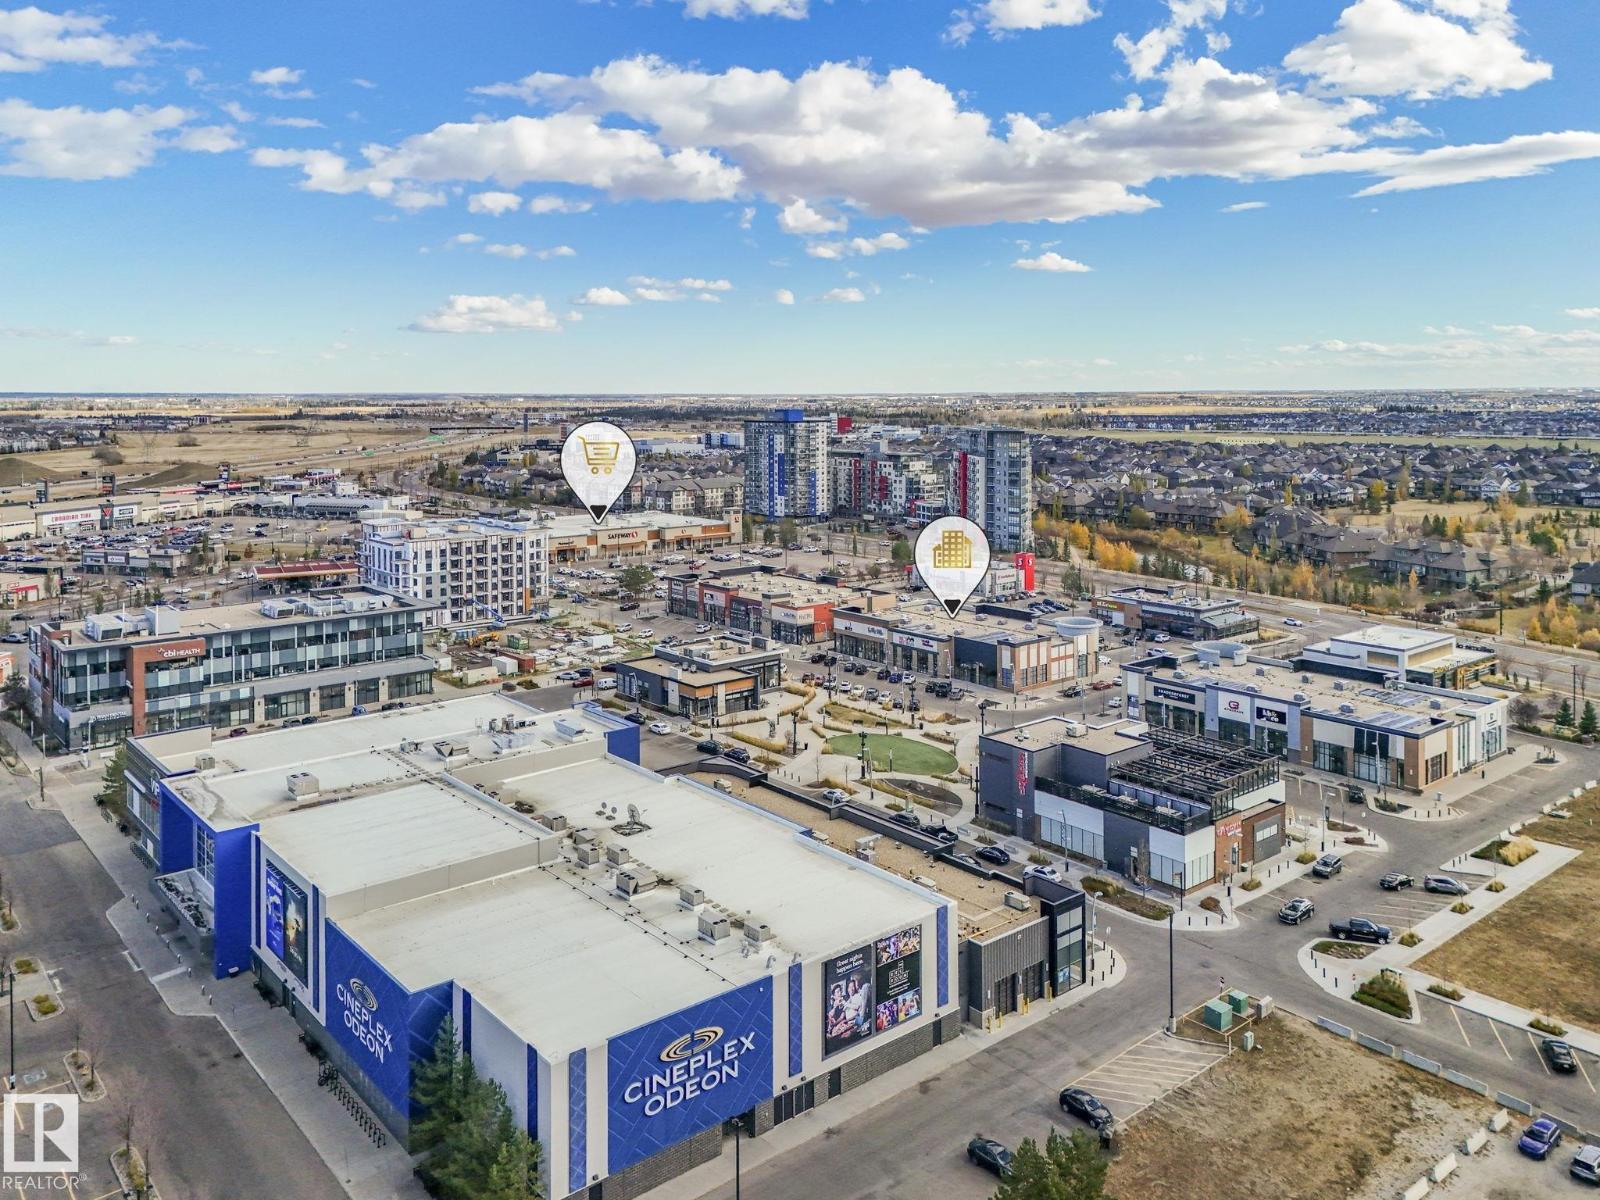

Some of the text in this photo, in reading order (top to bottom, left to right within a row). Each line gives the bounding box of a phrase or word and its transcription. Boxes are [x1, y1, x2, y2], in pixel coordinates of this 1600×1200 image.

[163, 648, 200, 657] cbi HEALTH
[336, 984, 393, 1053] CINEPLEX
[344, 1009, 384, 1064] ODEON
[624, 1031, 756, 1104] CINEPLEX
[644, 1060, 739, 1117] ODEON
